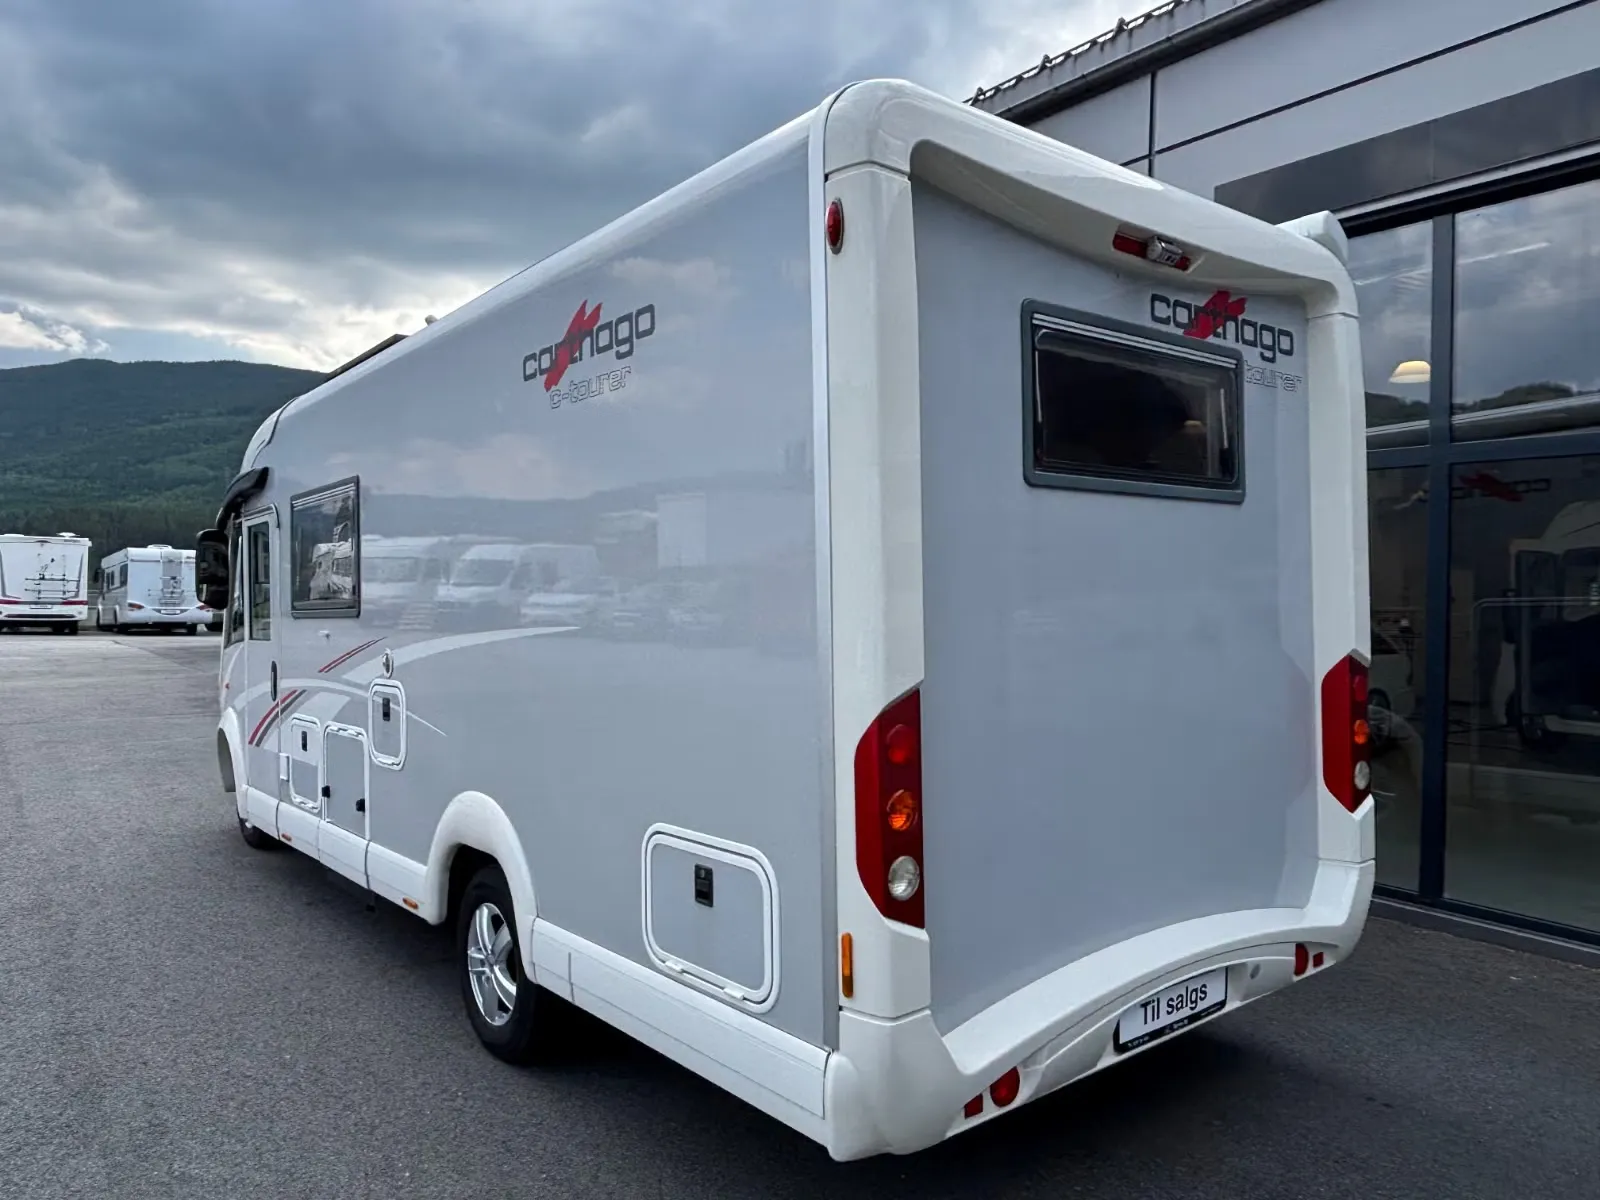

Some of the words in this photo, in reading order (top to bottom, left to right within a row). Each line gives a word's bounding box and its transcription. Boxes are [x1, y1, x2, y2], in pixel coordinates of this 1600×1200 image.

[523, 303, 656, 382] carthago
[1151, 293, 1294, 363] carthago
[550, 365, 632, 409] c-tourer
[1140, 997, 1160, 1025] Til
[1166, 983, 1208, 1016] salgs
